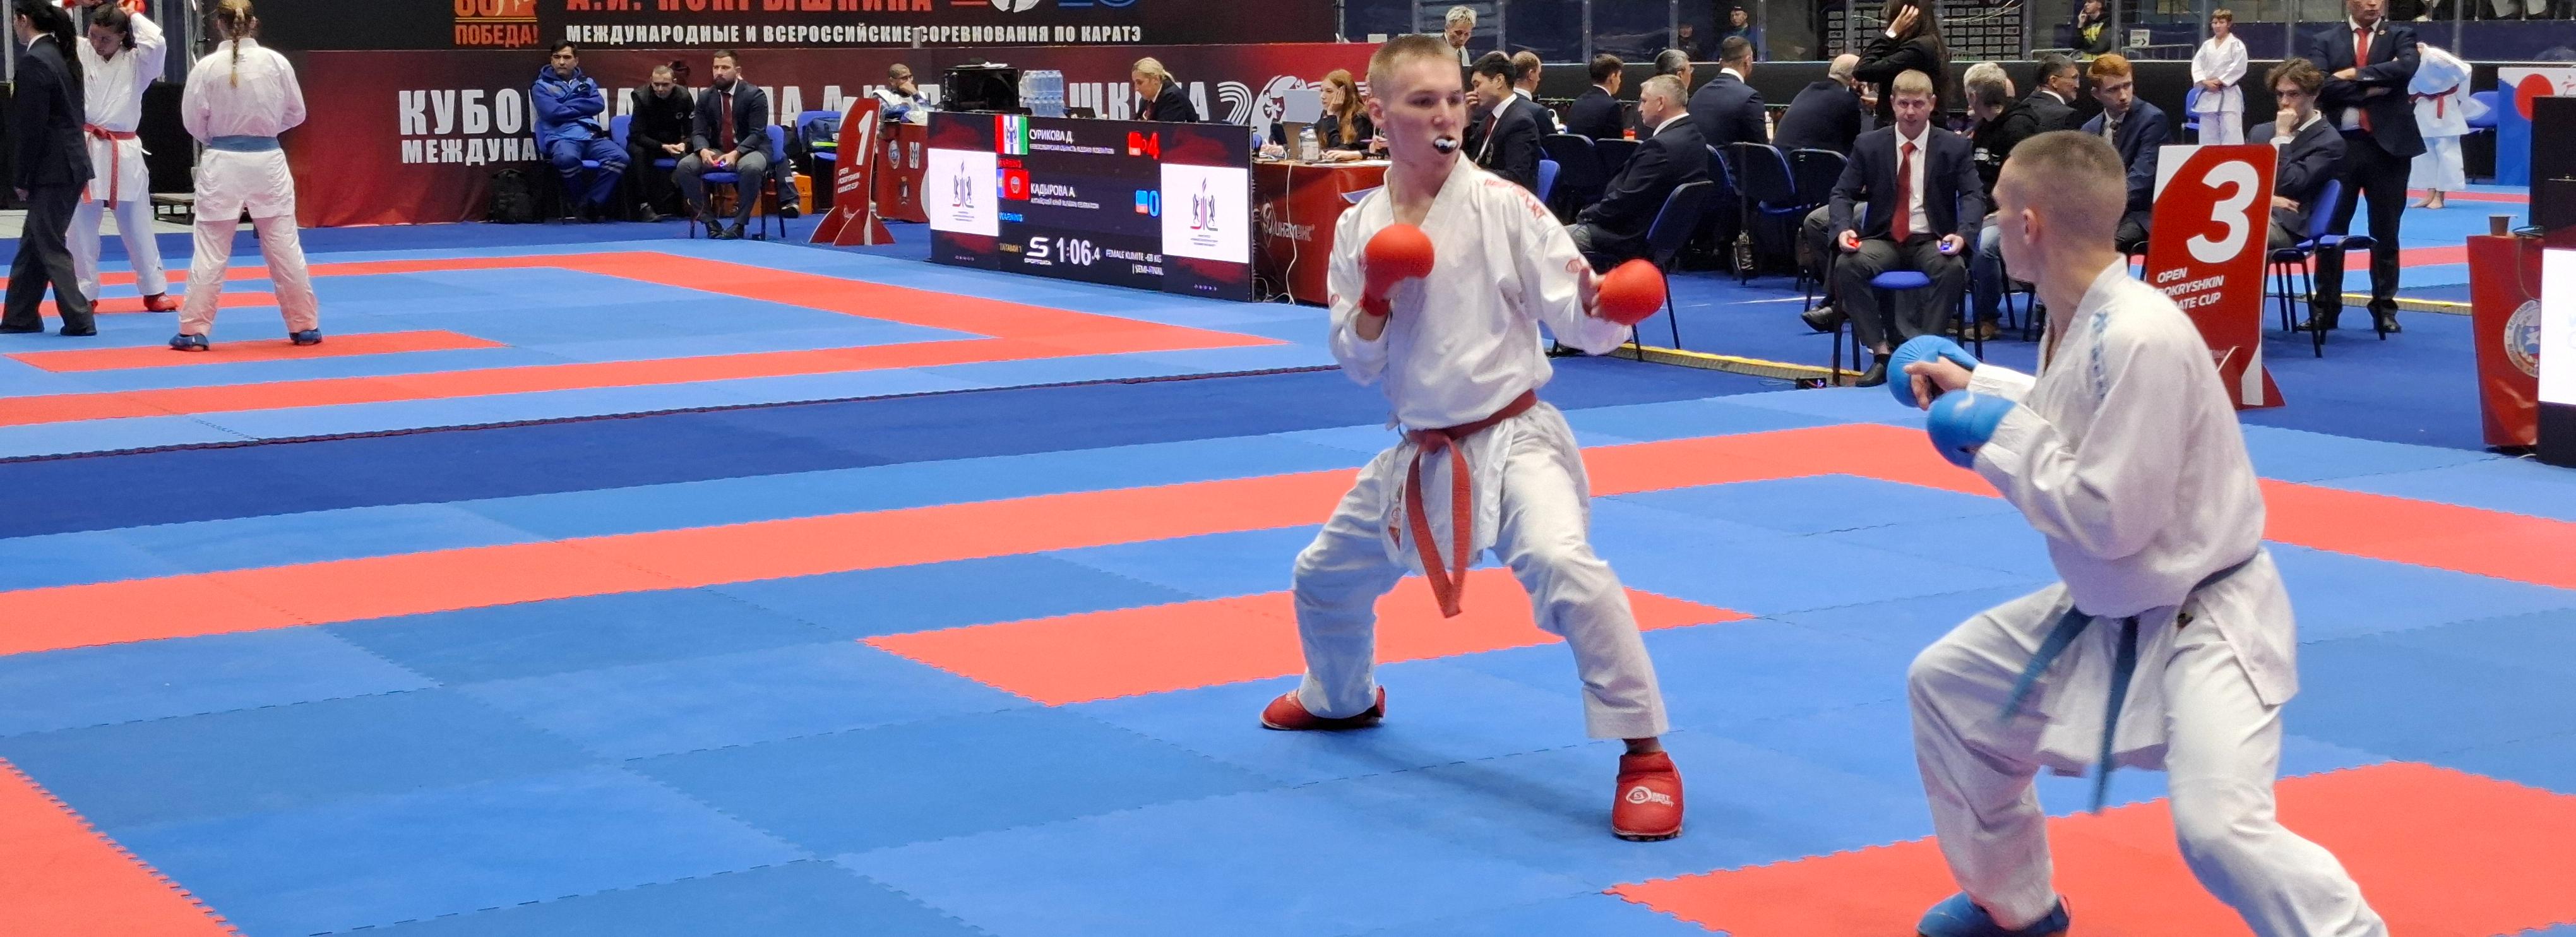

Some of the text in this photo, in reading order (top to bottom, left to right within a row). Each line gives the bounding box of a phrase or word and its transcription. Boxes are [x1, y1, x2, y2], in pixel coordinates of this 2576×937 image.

[455, 25, 539, 47] ПОБЕДА!
[567, 23, 1141, 44] МЕЖДУНАРОДНЫЕ И ВСЕРОССИЙСКИЕ СОРЕВНОВАНИЯ ПО КАРАТЭ
[398, 88, 537, 135] КУБО
[856, 110, 874, 165] 1
[1030, 129, 1065, 142] СУРИКОВА
[1148, 131, 1160, 160] 4
[402, 138, 543, 166] МЕЖДУНА
[1030, 183, 1068, 197] КАДЫРОВА
[1148, 191, 1159, 217] 0
[2186, 161, 2259, 263] 3
[2157, 266, 2188, 283] OPEN
[2198, 292, 2221, 306] CUP
